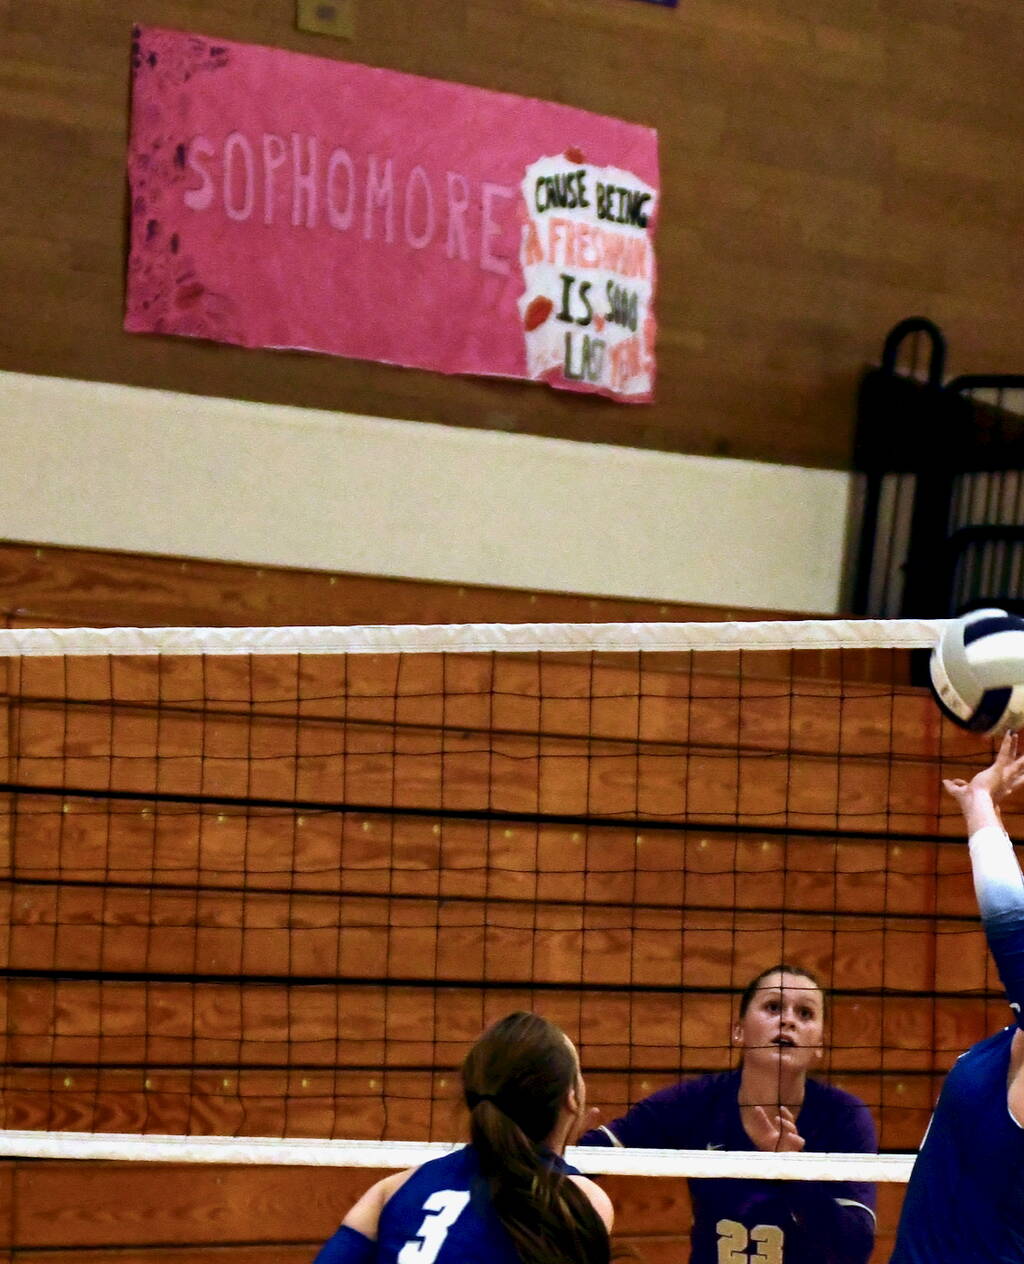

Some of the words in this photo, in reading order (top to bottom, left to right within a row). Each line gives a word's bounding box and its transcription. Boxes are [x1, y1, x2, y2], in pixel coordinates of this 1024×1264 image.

[184, 130, 514, 275] SOPHOMORE
[596, 182, 652, 228] BEING
[556, 273, 593, 326] IS
